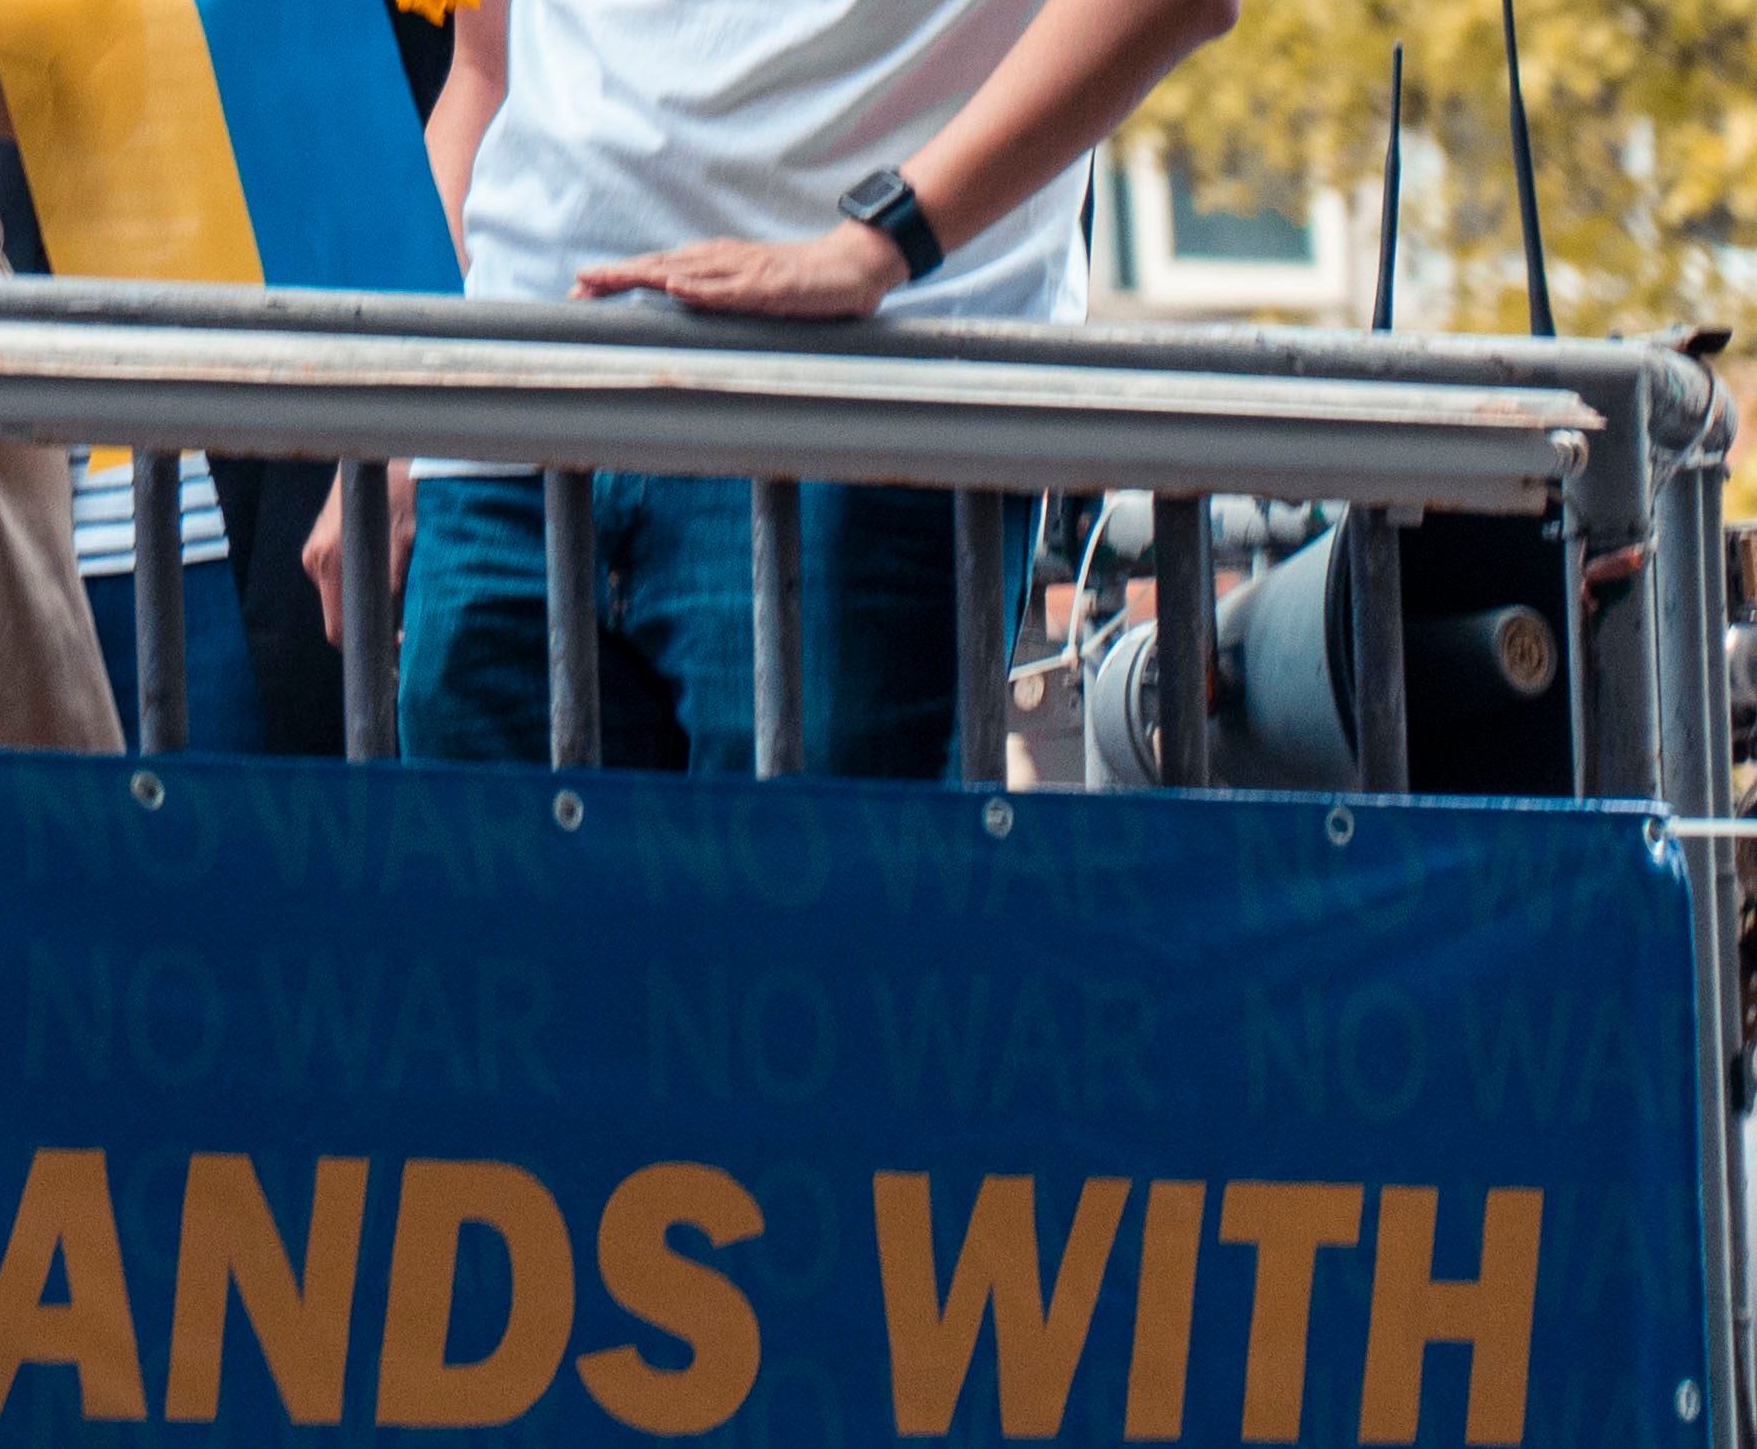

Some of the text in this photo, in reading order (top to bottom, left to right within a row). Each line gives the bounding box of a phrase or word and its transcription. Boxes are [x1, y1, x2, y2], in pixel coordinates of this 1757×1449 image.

[23, 937, 225, 1086] NO
[258, 946, 559, 1098] WAR
[645, 960, 838, 1104] NO
[868, 969, 1162, 1112] WAR
[872, 1171, 1544, 1445] WITH
